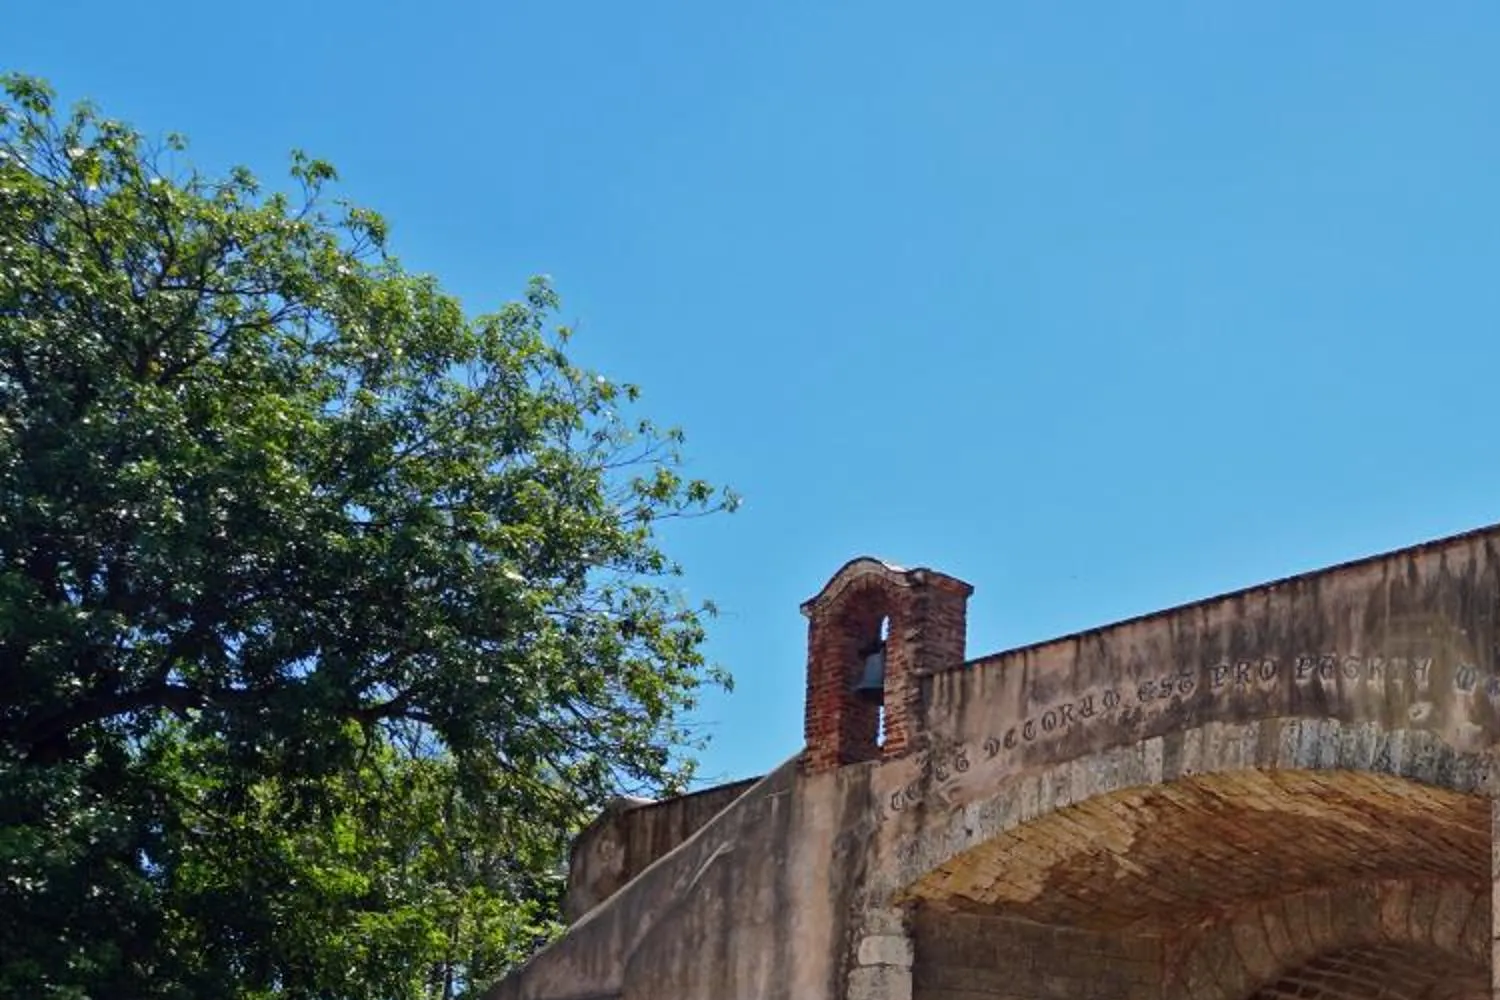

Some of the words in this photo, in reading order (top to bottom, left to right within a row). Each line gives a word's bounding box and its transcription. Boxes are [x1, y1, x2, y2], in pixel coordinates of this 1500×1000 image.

[983, 688, 1121, 761] DECORUM
[1137, 669, 1195, 701] EST
[1206, 657, 1277, 689] PRO
